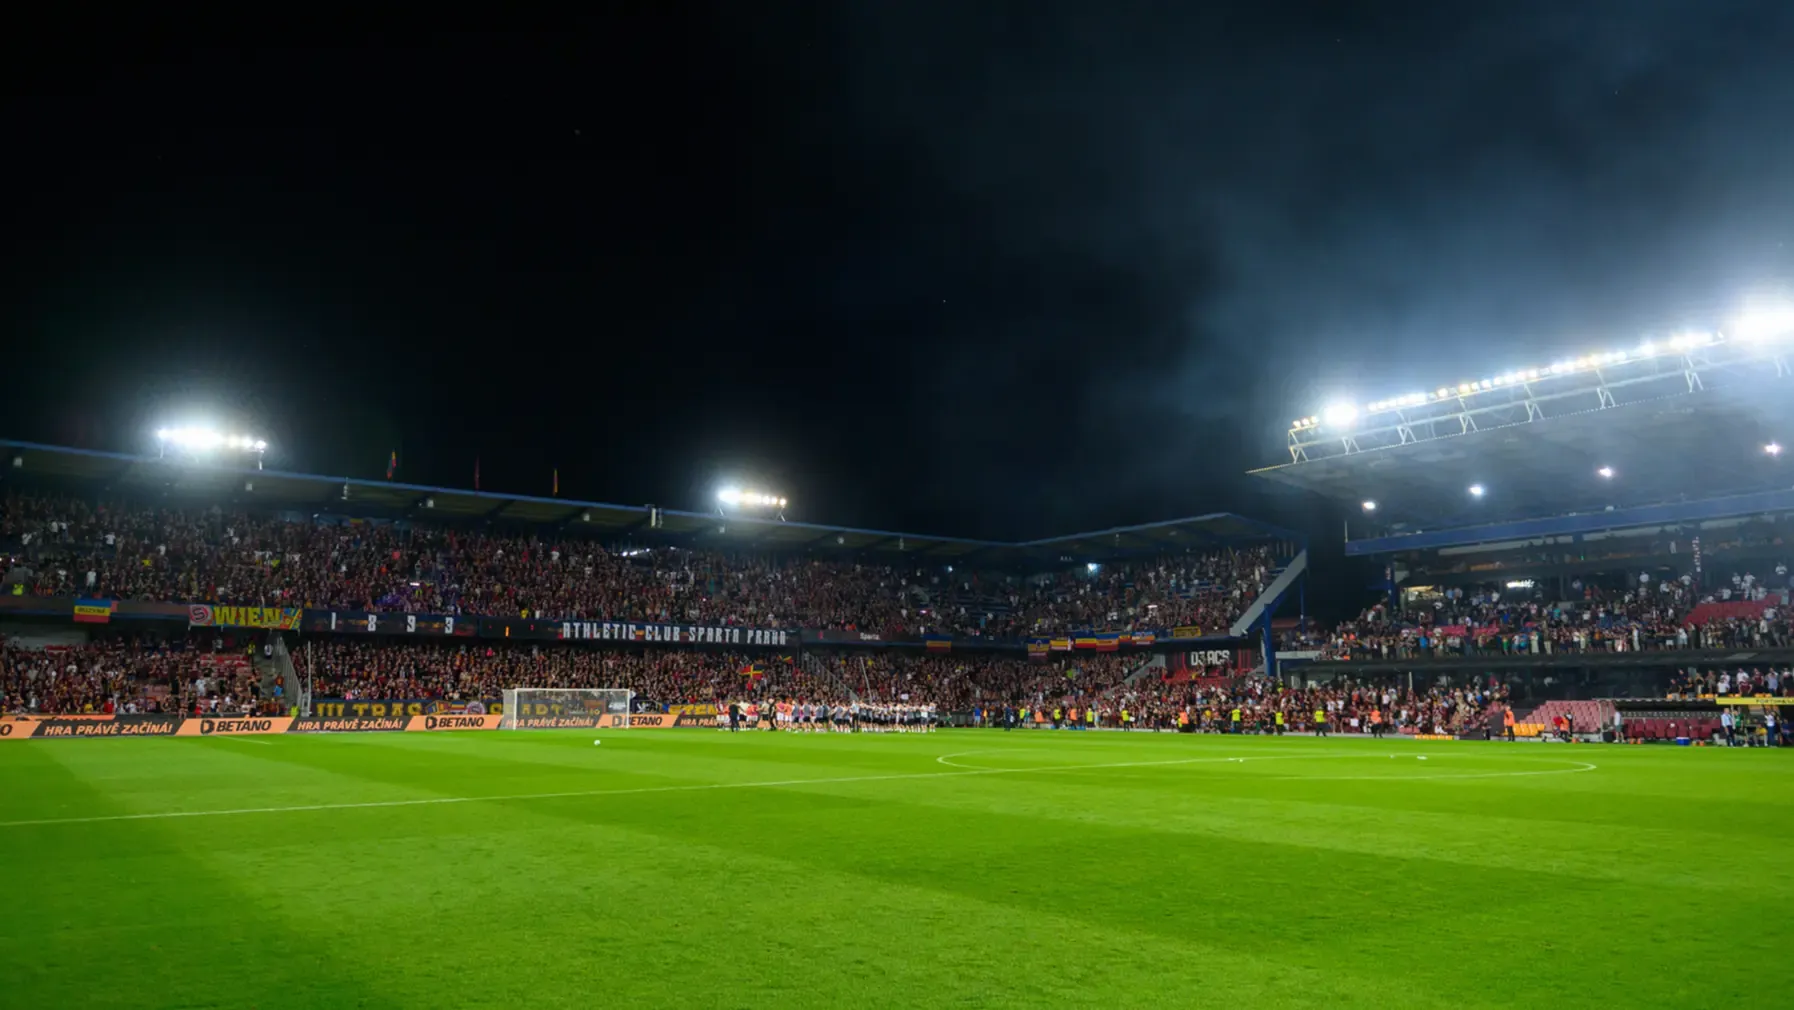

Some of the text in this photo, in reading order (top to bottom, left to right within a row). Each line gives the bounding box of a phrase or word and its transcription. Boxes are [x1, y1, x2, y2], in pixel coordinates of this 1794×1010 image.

[214, 606, 281, 626] WIEN
[563, 622, 786, 645] ATHLETIC CLUB SPARTA PRAHA
[44, 720, 173, 736] HRA PRÁVĚ ZAČÍNÁ!
[216, 719, 272, 732] BETANO
[297, 718, 403, 731] HRA PRÁVĚ ZAČÍNÁ!
[438, 716, 485, 728] BETANO
